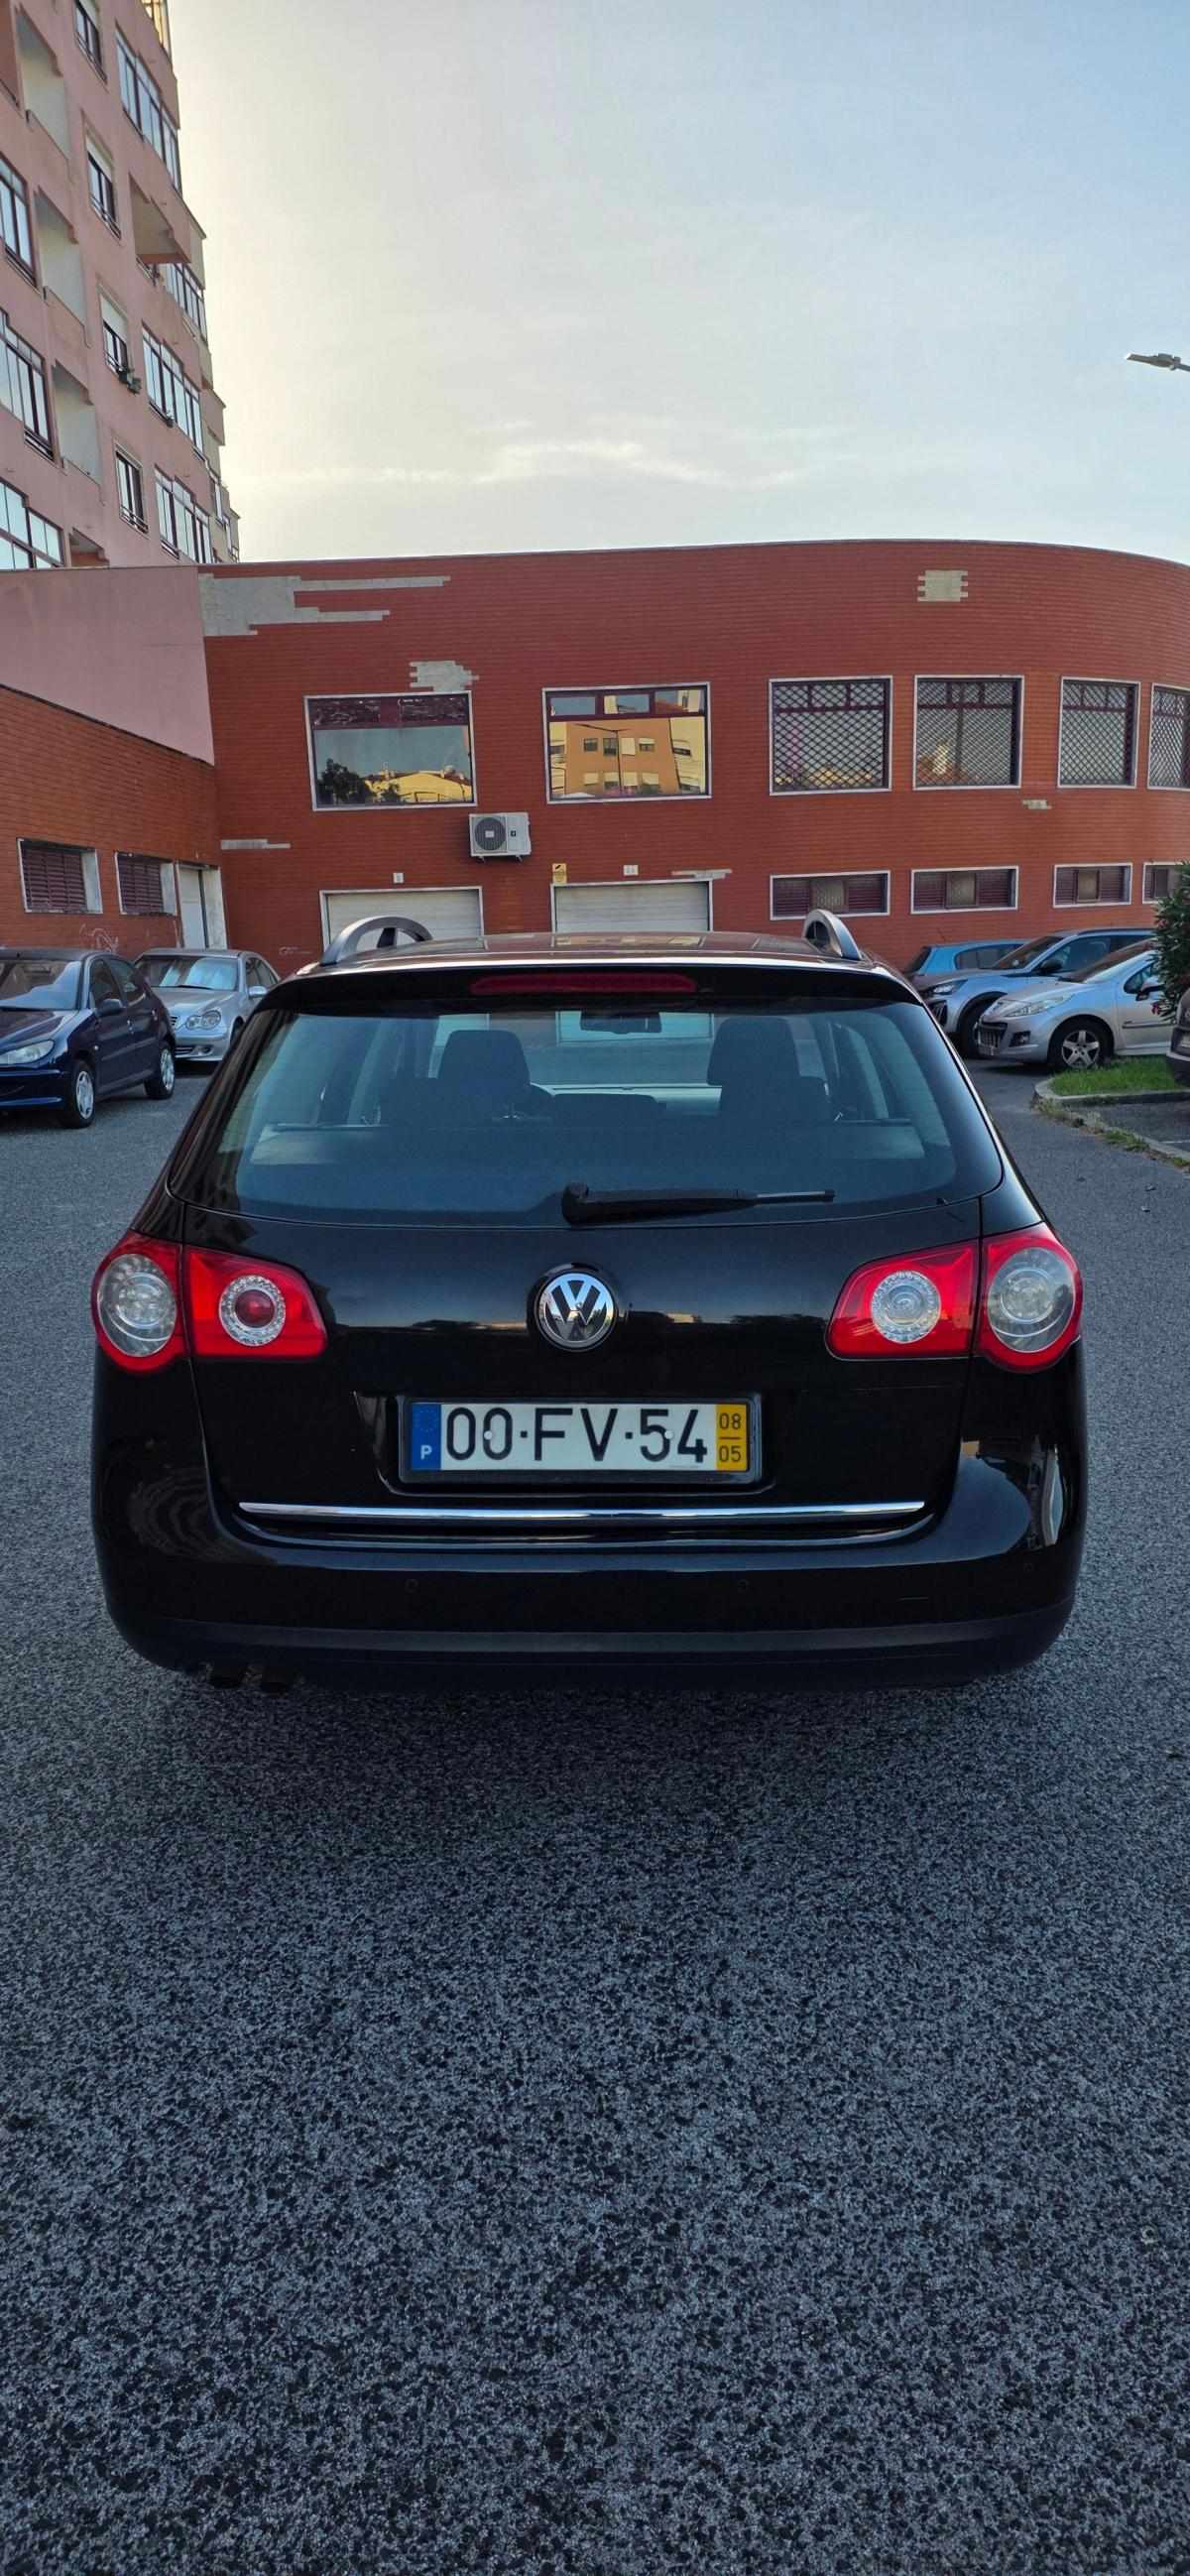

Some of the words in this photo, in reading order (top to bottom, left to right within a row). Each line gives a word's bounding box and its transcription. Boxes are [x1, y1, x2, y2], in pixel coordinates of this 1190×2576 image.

[538, 1273, 614, 1348] VW
[718, 1411, 741, 1430] 08
[419, 1444, 432, 1460] P
[718, 1444, 742, 1463] 05
